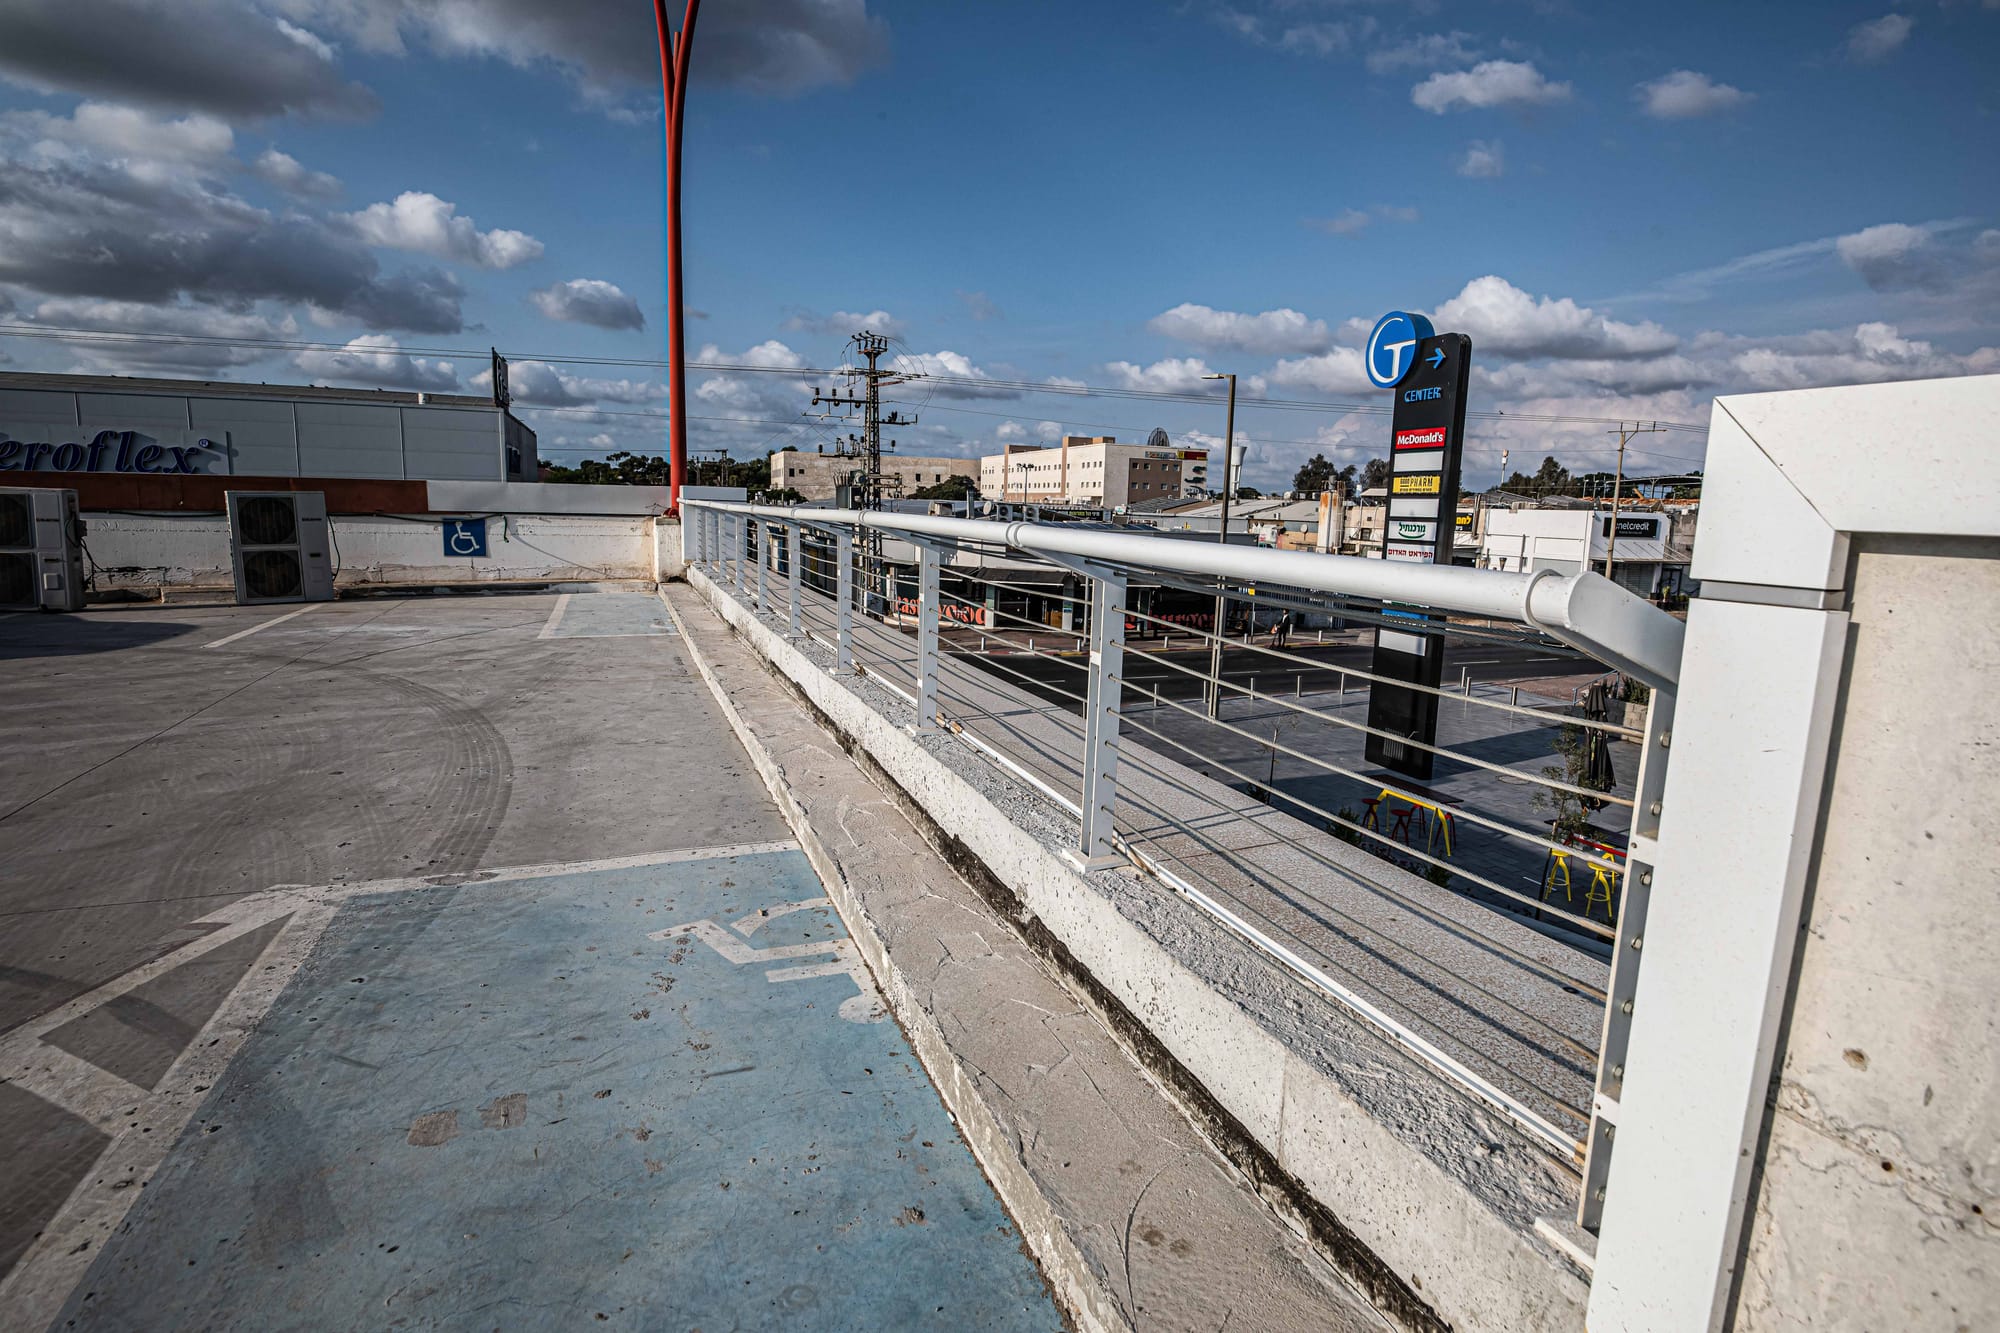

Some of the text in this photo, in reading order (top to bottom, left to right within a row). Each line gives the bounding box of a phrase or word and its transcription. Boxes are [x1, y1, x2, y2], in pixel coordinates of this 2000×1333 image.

[1404, 387, 1441, 403] CENTER
[1397, 431, 1443, 445] McDonald's
[1399, 522, 1426, 533] מרכנתיל
